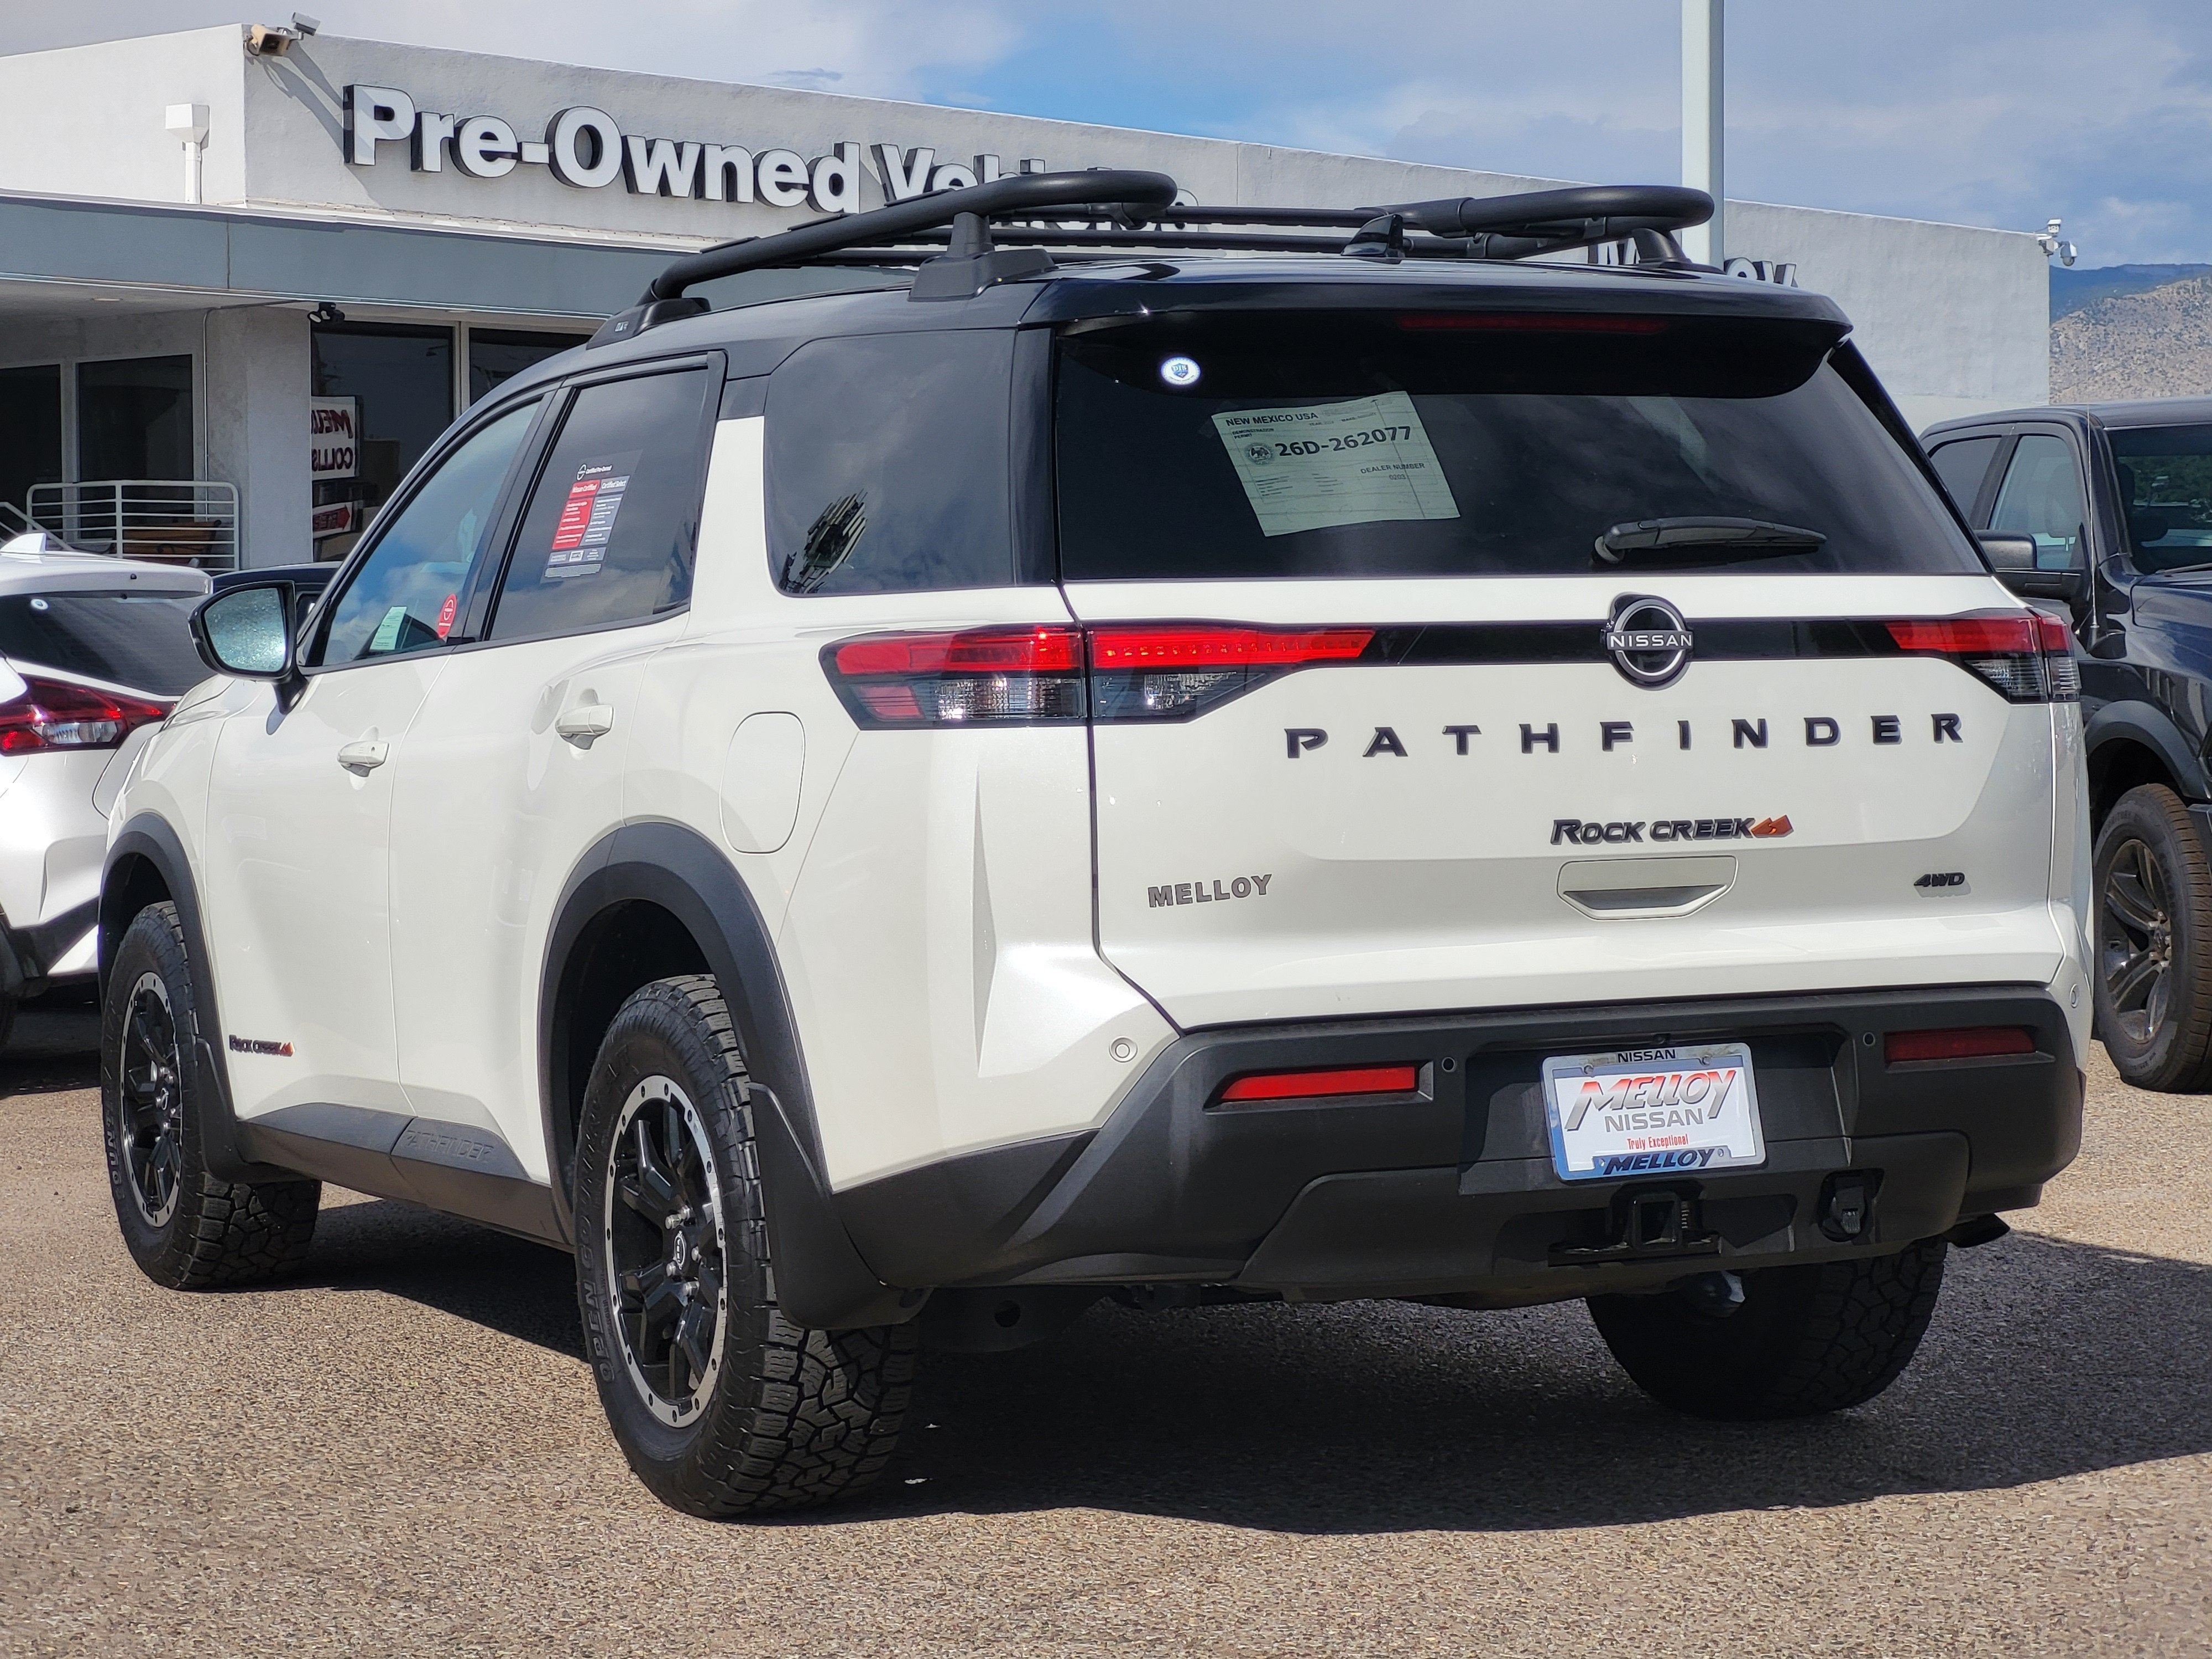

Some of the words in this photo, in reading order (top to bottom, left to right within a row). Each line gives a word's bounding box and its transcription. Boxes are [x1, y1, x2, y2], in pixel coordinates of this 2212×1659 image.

[343, 84, 860, 214] Pre-Owned
[1225, 418, 1250, 426] NEW
[1253, 414, 1293, 424] MEXICO
[1295, 412, 1318, 421] USA
[1275, 426, 1411, 457] 26D-262077
[1360, 464, 1391, 474] DEALER
[1610, 633, 1693, 648] NISSAN
[1284, 713, 1963, 758] PATHFINDER
[1550, 818, 1646, 846] ROCK
[1649, 817, 1756, 842] CREEK
[1147, 873, 1272, 907] MELLOY
[1913, 872, 1965, 887] 4WD
[1617, 1049, 1676, 1063] NISSAN
[1564, 1070, 1737, 1132] MELLOY
[1604, 1108, 1704, 1133] NISSAN
[1627, 1138, 1646, 1150] Truly
[1648, 1134, 1689, 1149] Exceptional
[1603, 1148, 1716, 1176] MELLOY
